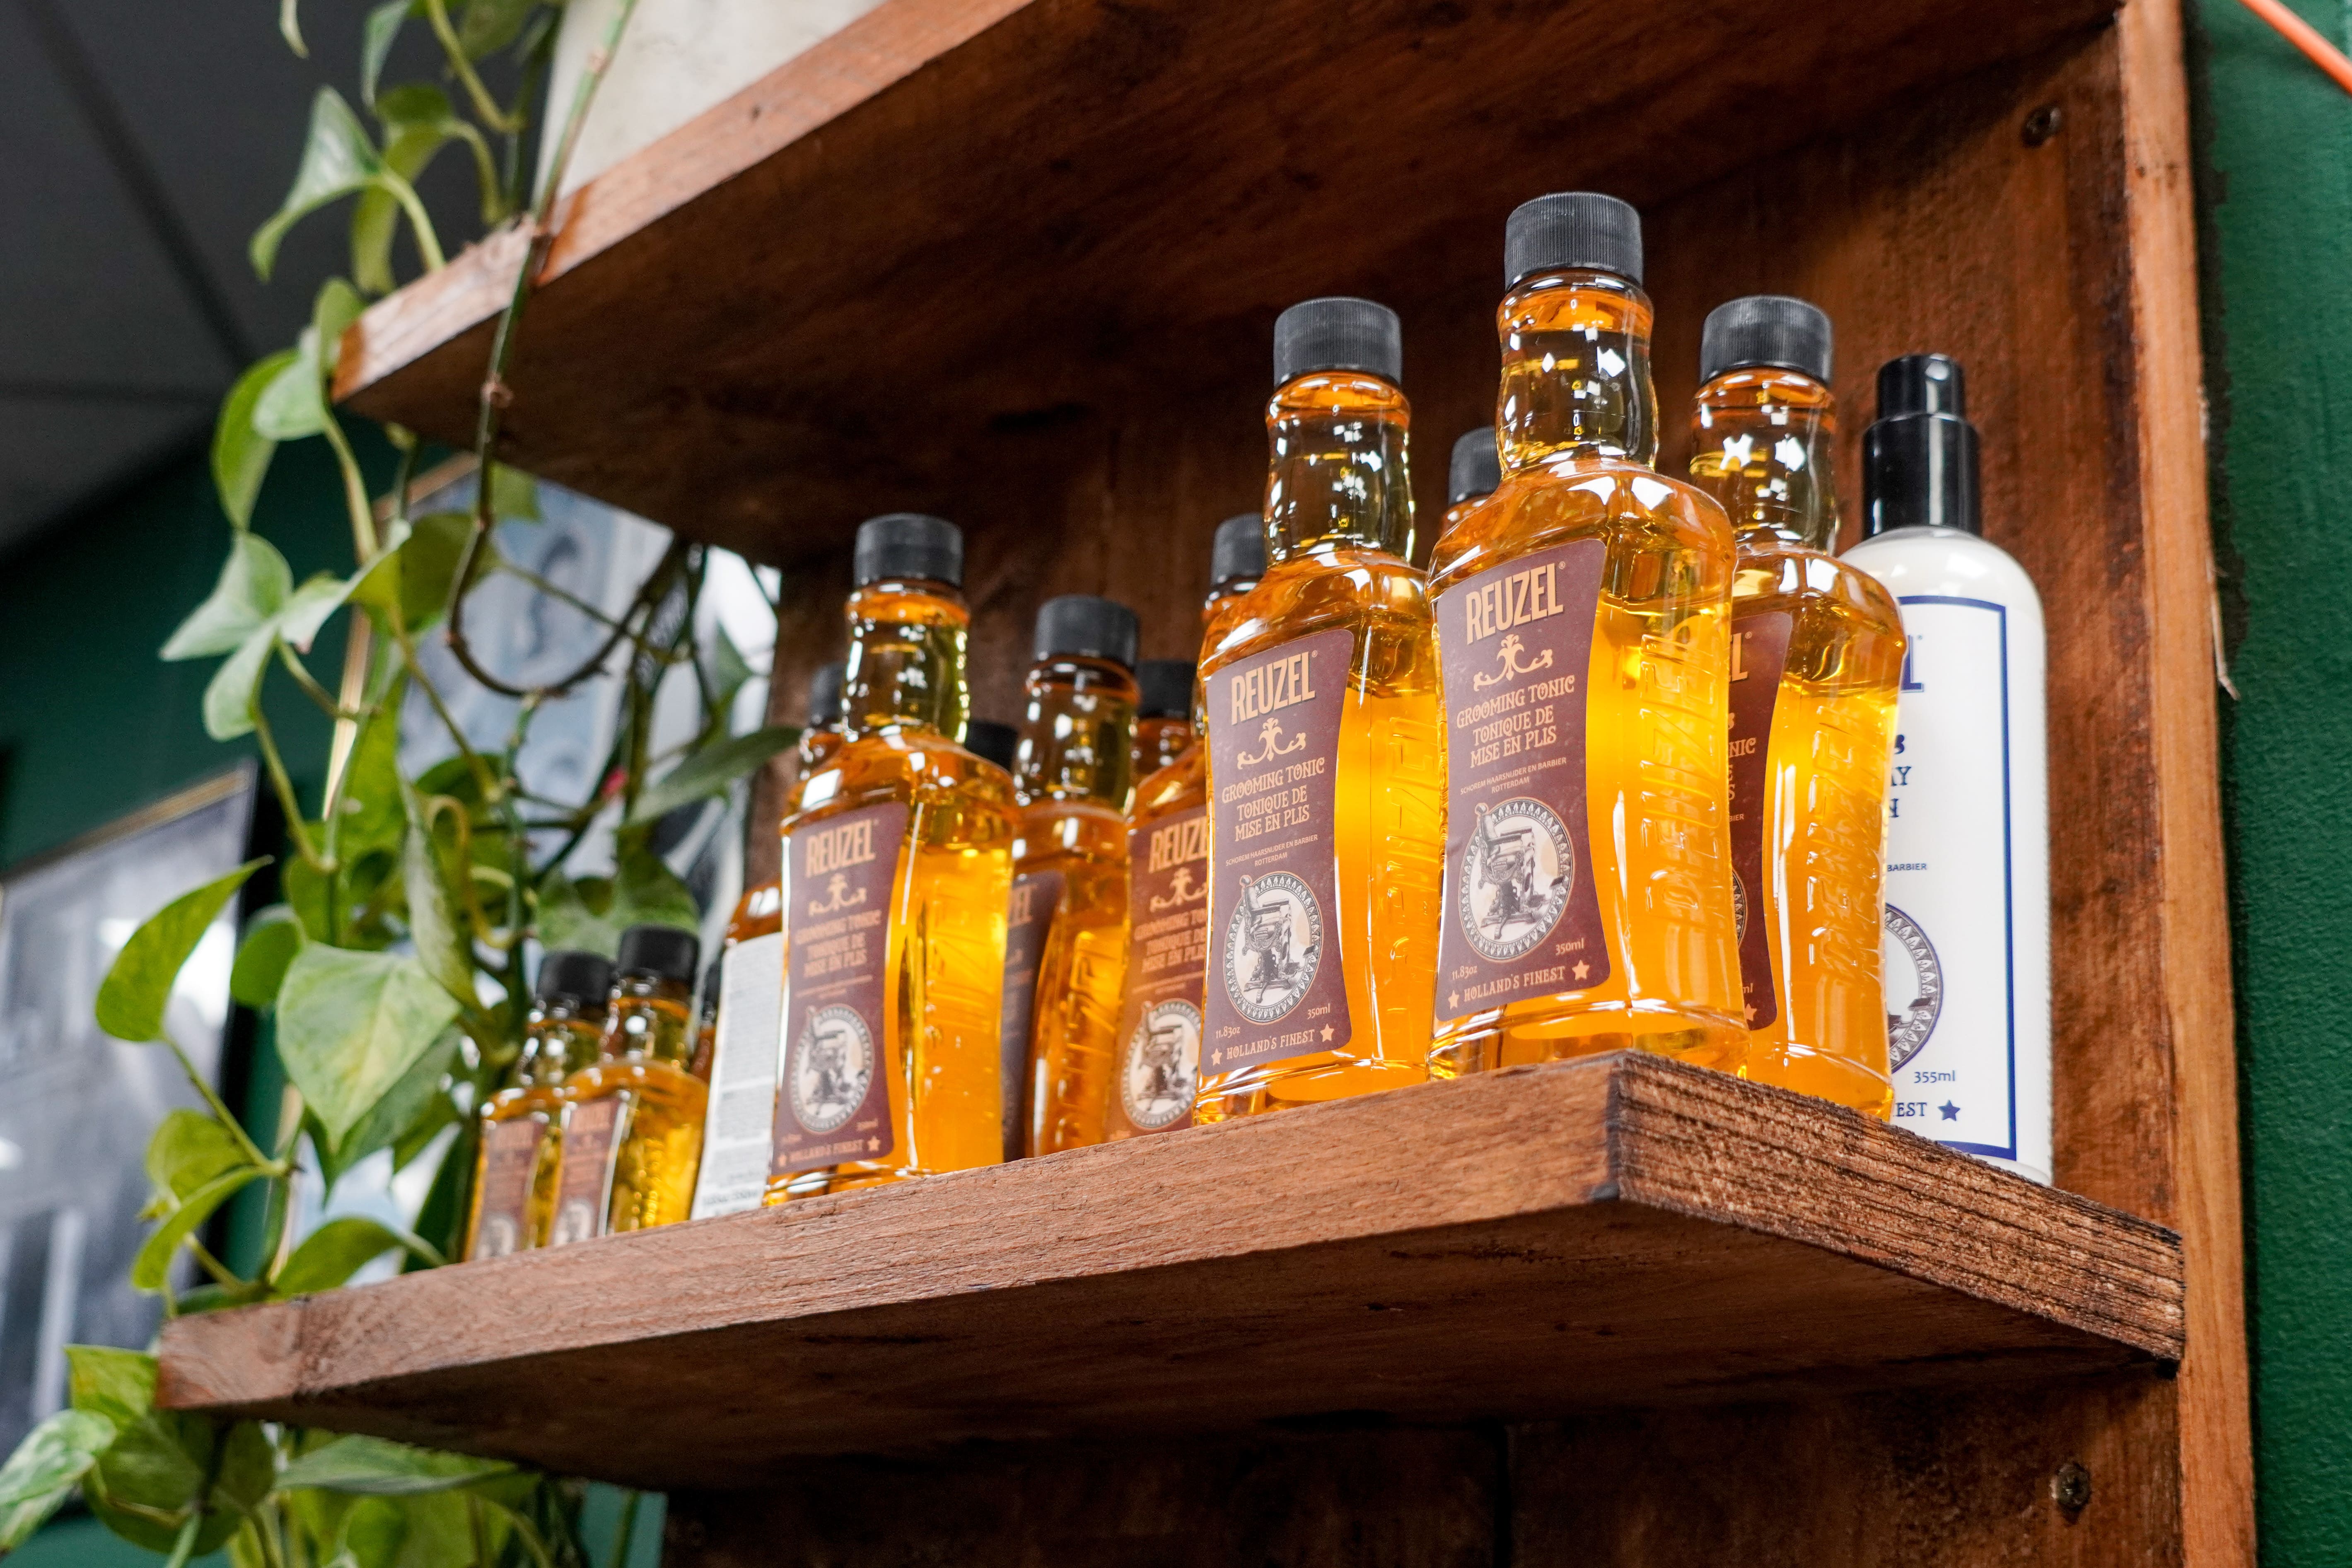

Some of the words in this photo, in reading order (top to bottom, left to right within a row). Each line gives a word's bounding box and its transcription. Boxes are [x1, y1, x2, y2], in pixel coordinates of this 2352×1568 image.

[1466, 563, 1564, 645] REUZEL
[1231, 651, 1315, 726] REUZEL
[1456, 689, 1525, 729] GROOMING
[1528, 675, 1575, 703] TONIC
[1473, 711, 1531, 746] TONIQUE
[1535, 705, 1554, 726] DE
[1471, 743, 1500, 768] MISE
[1503, 735, 1521, 757] EN
[1525, 726, 1557, 751] PLIS
[1729, 737, 1757, 759] NIC
[1222, 769, 1284, 804] GROOMING
[1285, 757, 1325, 783] TONIC
[1460, 780, 1486, 795] SCHOREM
[1528, 765, 1536, 773] EN
[1538, 757, 1567, 770] BARBIER
[1491, 776, 1530, 794] ROTTERDAM
[1237, 790, 1289, 821] TONIQUE
[1292, 785, 1307, 805] DE
[1729, 813, 1744, 822] BIER
[1235, 818, 1262, 842] MISE
[1265, 813, 1281, 833] EN
[1283, 804, 1310, 828] PLIS
[1148, 815, 1207, 874] REUZ
[1226, 853, 1250, 866] SCHOREM
[1294, 834, 1318, 846] BARBIER
[1255, 852, 1287, 867] ROTTERDAM
[1887, 863, 1927, 872] BARBIER
[1555, 937, 1585, 956] 350ml
[1451, 965, 1478, 981] 11.83oz
[1463, 974, 1520, 1002] HOLLAND'S
[1523, 966, 1565, 987] FINEST
[1307, 1003, 1331, 1020] 350ml
[1215, 1026, 1241, 1039] 11.83oz
[1226, 1036, 1277, 1060] HOLLAND'S
[1280, 1029, 1315, 1048] FINEST
[1914, 1070, 1956, 1084] 355ml
[1894, 1102, 1927, 1117] EST
